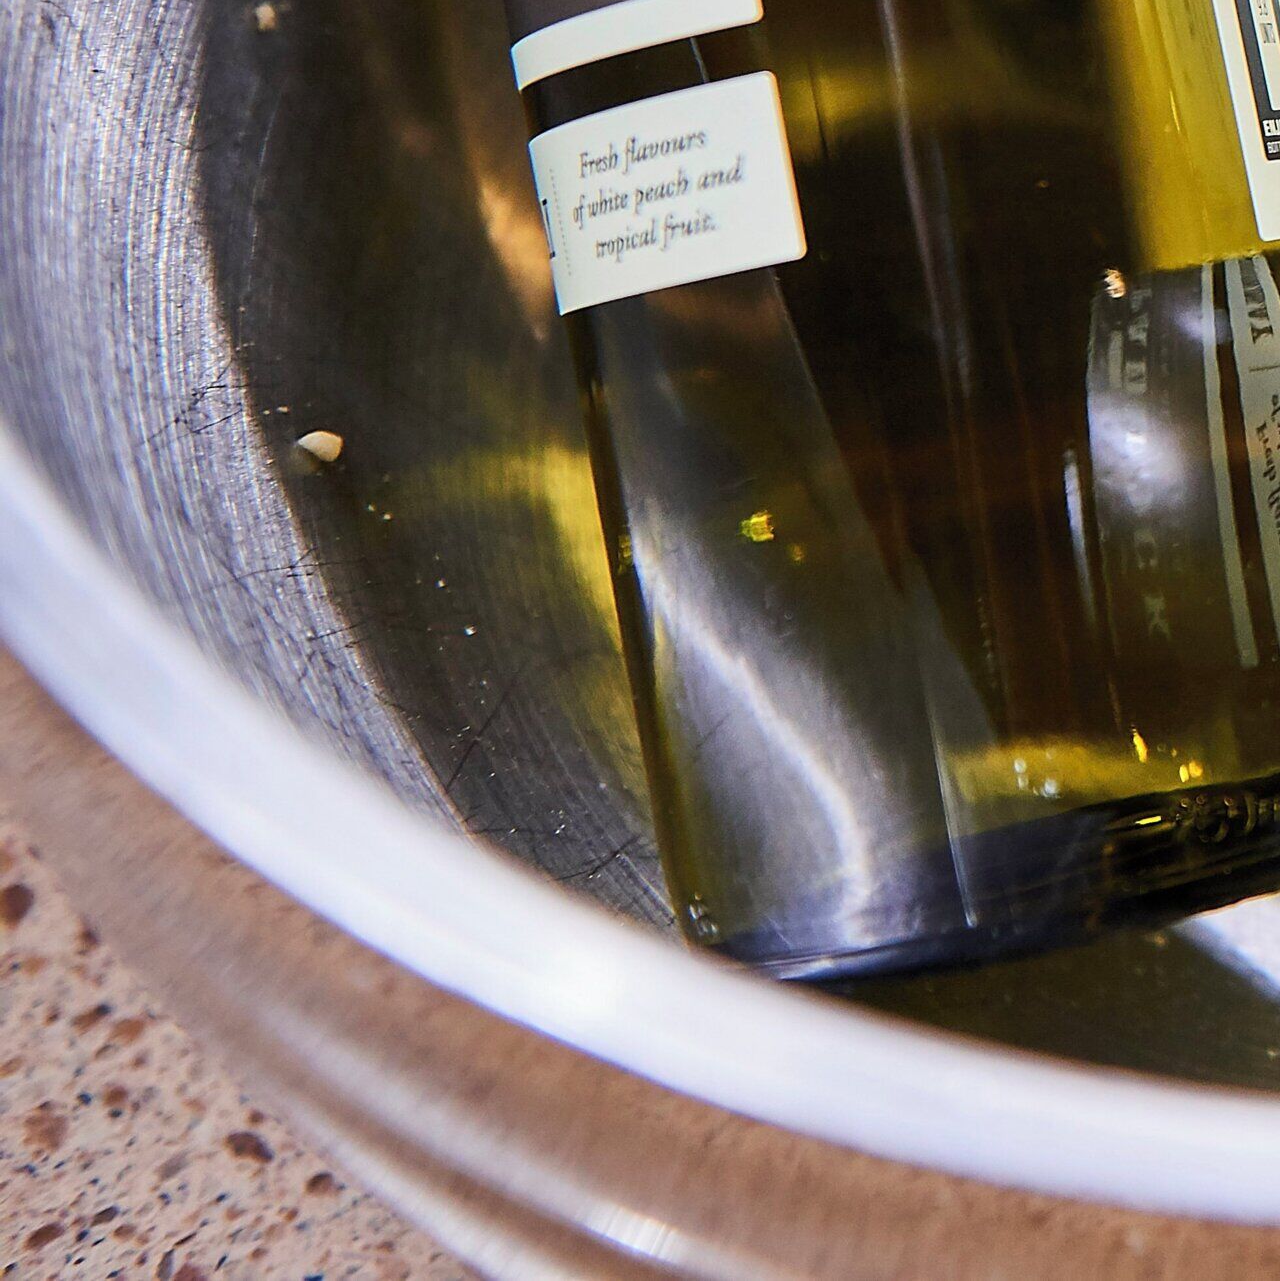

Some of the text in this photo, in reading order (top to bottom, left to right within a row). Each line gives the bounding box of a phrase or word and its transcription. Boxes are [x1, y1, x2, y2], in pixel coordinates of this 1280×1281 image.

[579, 131, 707, 179] Fresh flavours
[573, 153, 745, 230] of white peach and
[595, 209, 718, 263] tropical fruit.
